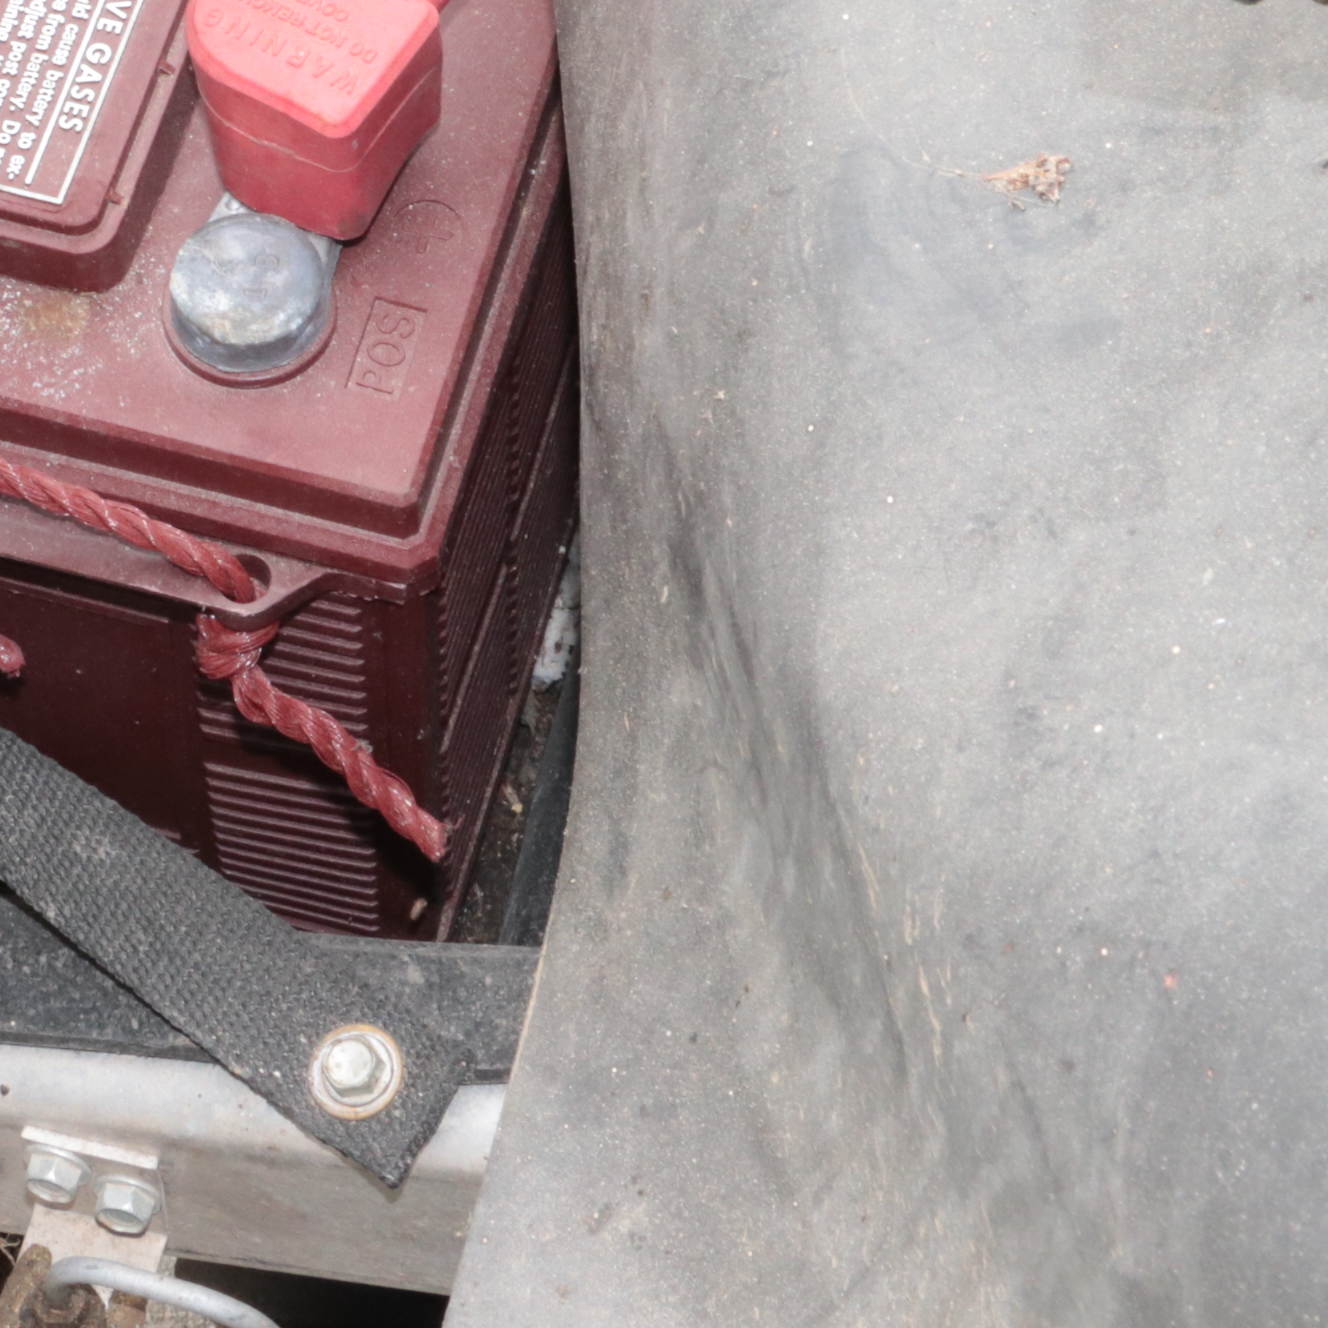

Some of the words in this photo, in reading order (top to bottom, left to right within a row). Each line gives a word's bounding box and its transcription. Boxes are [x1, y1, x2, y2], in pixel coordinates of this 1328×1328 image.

[35, 13, 65, 50] from
[51, 23, 79, 65] cause
[202, 4, 360, 95] WARNING
[304, 19, 348, 51] NOT
[1, 40, 27, 75] post
[347, 40, 378, 65] DO
[9, 52, 49, 111] battery.
[25, 69, 64, 126] battery
[58, 42, 112, 131] GASES
[17, 132, 36, 149] to
[6, 155, 25, 179] ex-
[356, 316, 416, 392] POS
